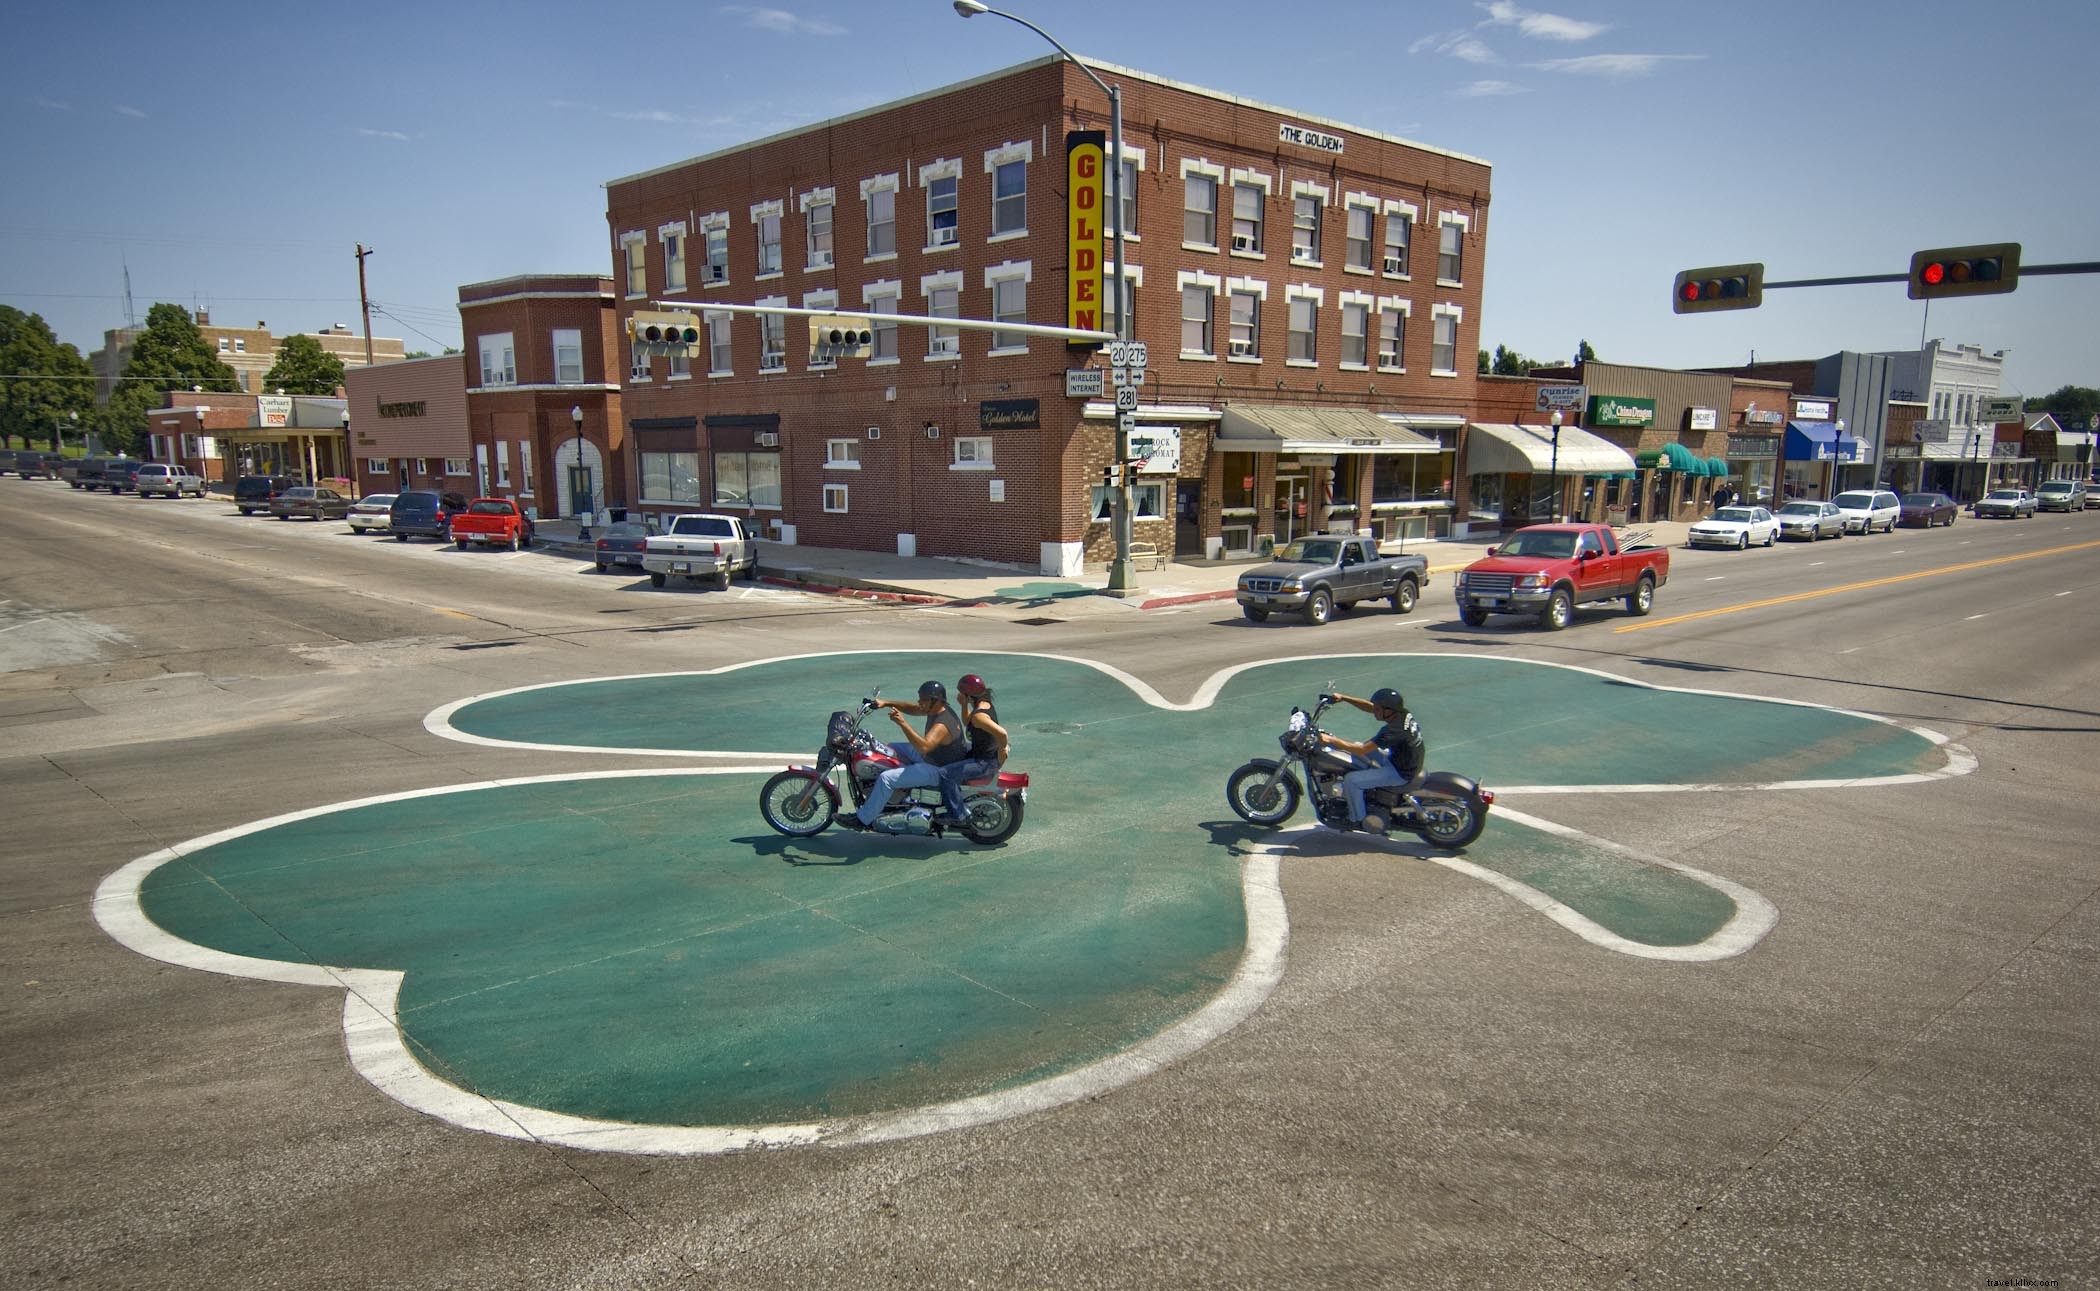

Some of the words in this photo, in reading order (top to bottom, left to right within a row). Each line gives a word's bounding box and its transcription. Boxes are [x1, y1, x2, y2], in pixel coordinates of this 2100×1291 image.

[1284, 127, 1302, 143] THE
[1305, 132, 1339, 151] GOLDEN
[1076, 154, 1096, 331] GOLDEN
[1112, 347, 1125, 362] 20
[1129, 347, 1146, 362] 275
[1070, 374, 1101, 383] WIRELESS
[1070, 385, 1100, 393] INTERNET
[1119, 390, 1135, 405] 281
[983, 411, 1010, 426] Golden
[1012, 410, 1036, 422] Hotel
